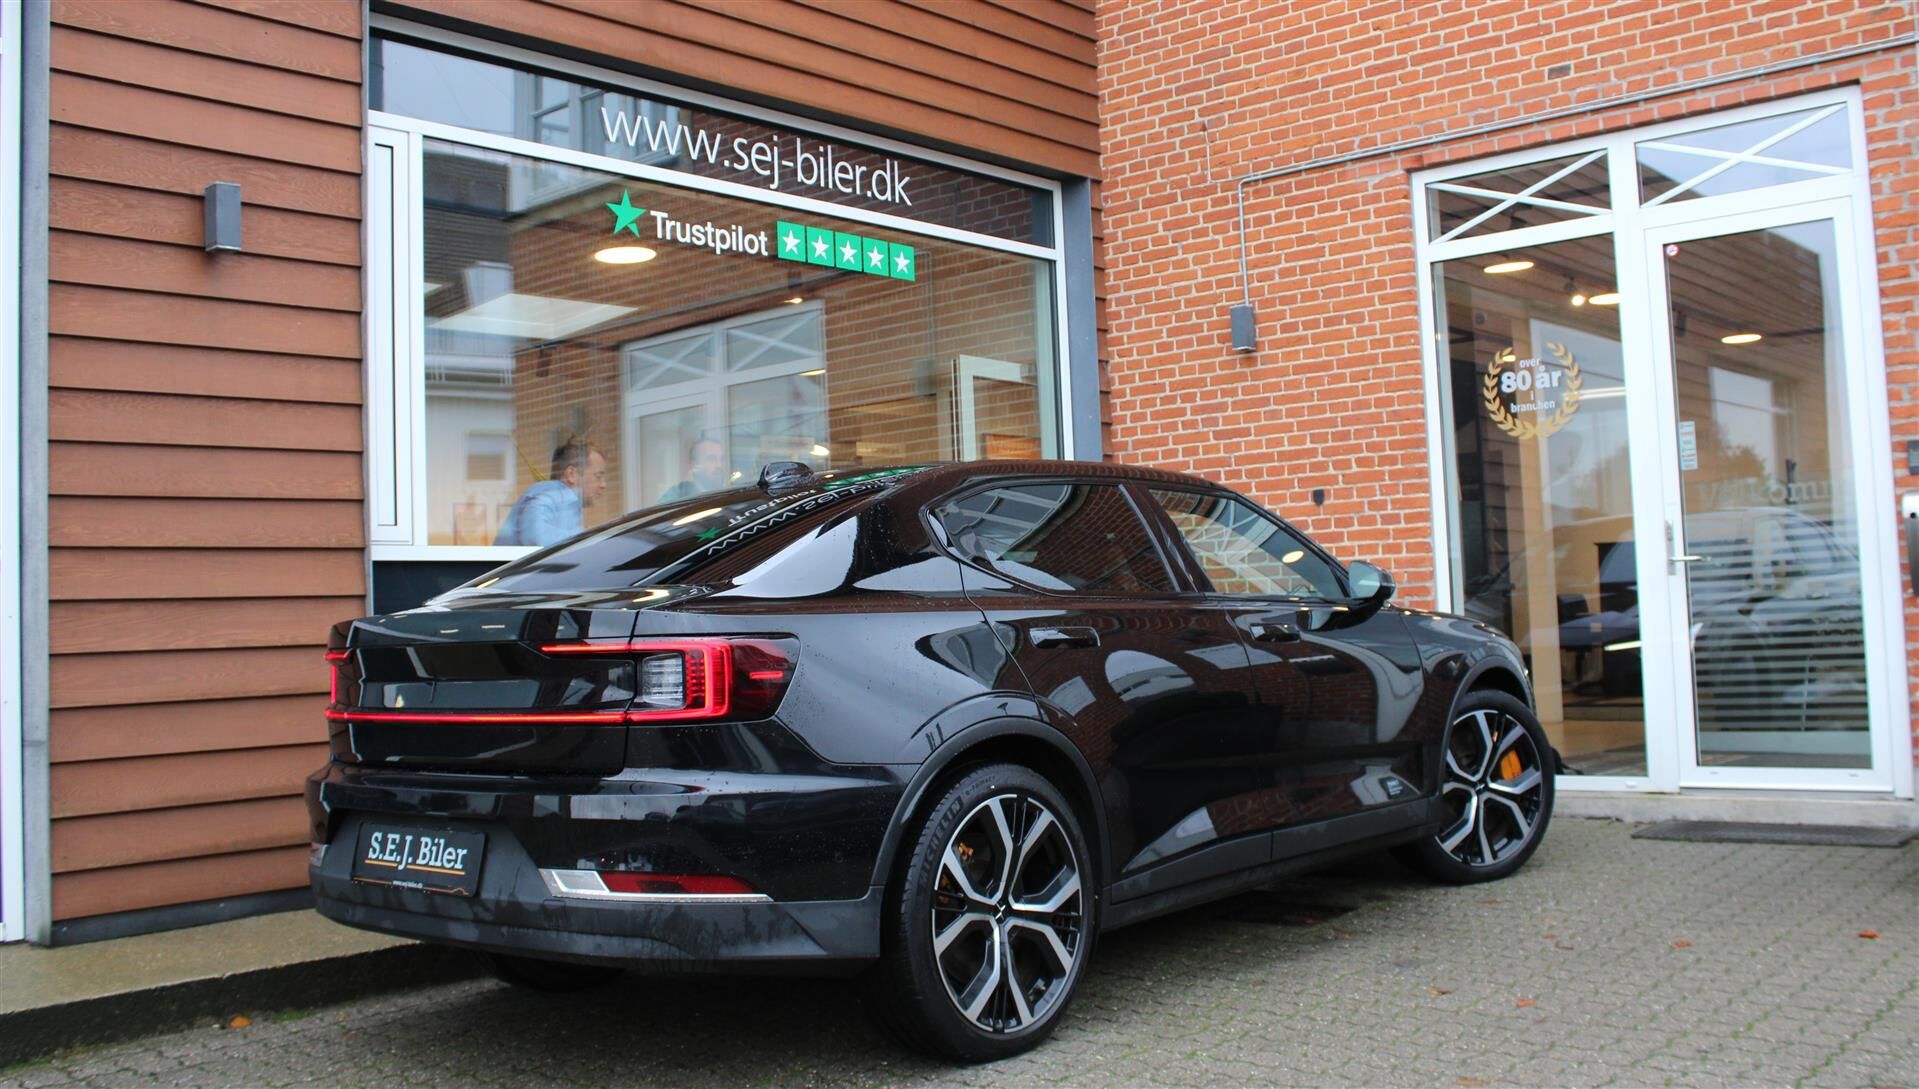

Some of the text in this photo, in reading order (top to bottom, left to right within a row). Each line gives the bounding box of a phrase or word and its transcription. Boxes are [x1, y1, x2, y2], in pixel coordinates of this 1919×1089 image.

[601, 106, 912, 206] www.sej-biler.dk
[649, 210, 768, 257] Trustpilot
[1501, 365, 1562, 394] 80 år
[1519, 358, 1541, 369] over
[1510, 400, 1556, 413] branchen
[367, 831, 468, 871] S.E.J. Biler
